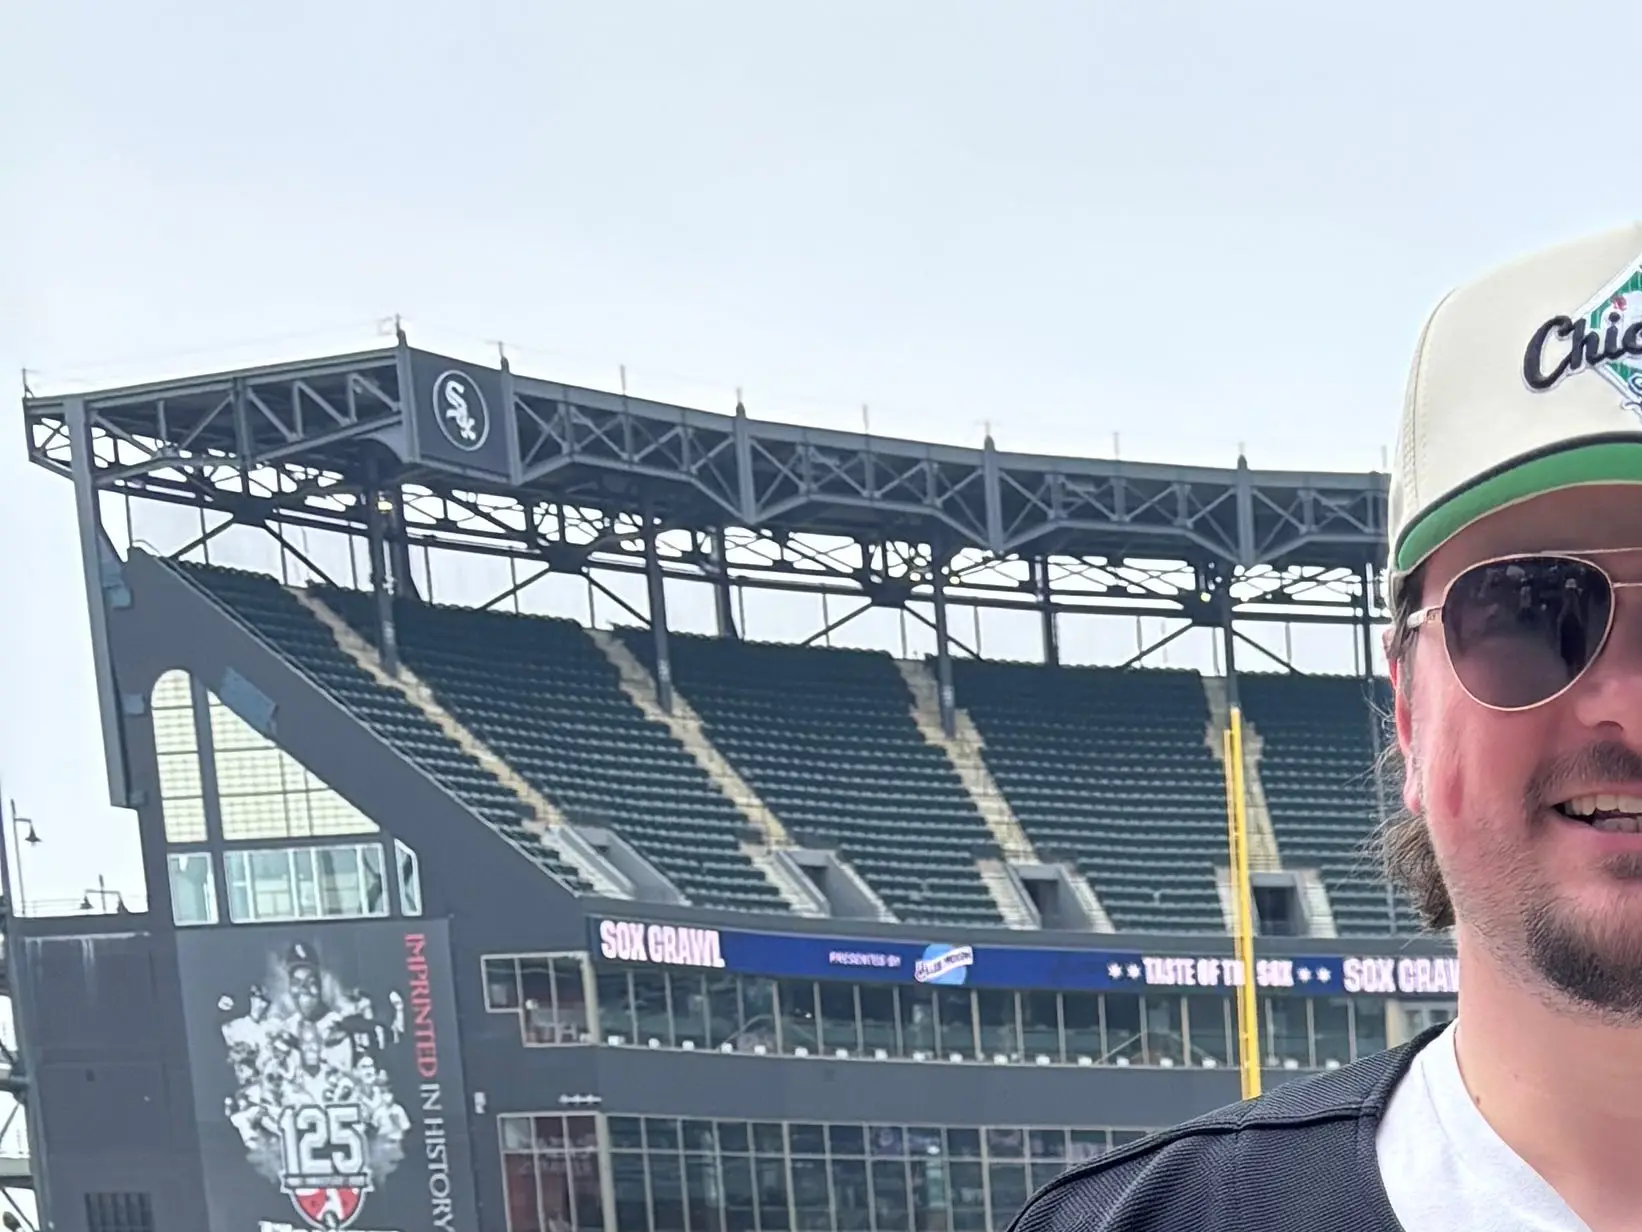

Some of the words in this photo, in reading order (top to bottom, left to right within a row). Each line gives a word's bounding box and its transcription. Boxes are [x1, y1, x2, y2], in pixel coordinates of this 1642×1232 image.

[600, 920, 647, 961] SOX
[1142, 957, 1196, 986] TASTE
[1343, 957, 1396, 992] SOX
[404, 933, 437, 1078] IMPRINTED
[419, 1083, 443, 1111] IN
[279, 1104, 366, 1175] 125
